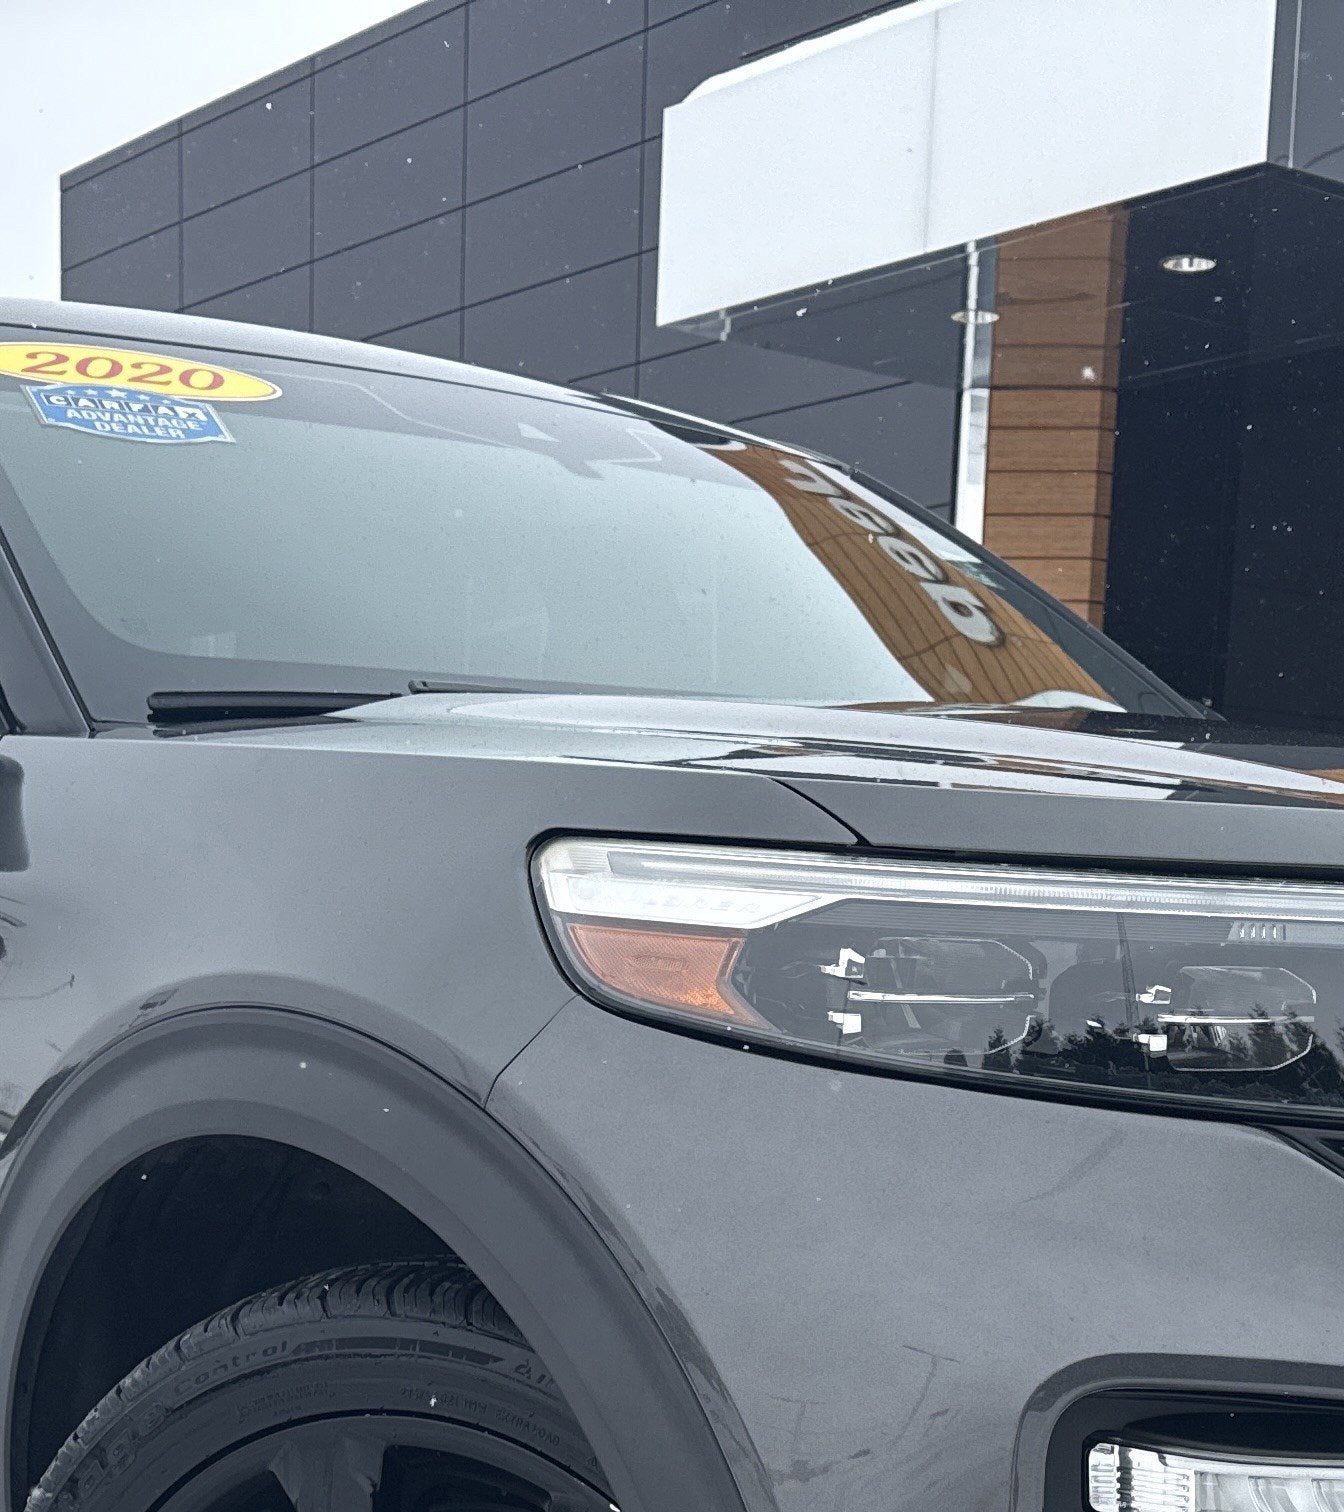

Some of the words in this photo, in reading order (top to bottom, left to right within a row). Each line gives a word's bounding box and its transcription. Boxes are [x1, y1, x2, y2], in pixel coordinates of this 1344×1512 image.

[20, 350, 226, 391] 2020
[46, 394, 209, 422] CARFAX
[65, 408, 203, 431] ADVANTAGE
[93, 421, 186, 439] DEALER
[173, 1337, 292, 1397] Control
